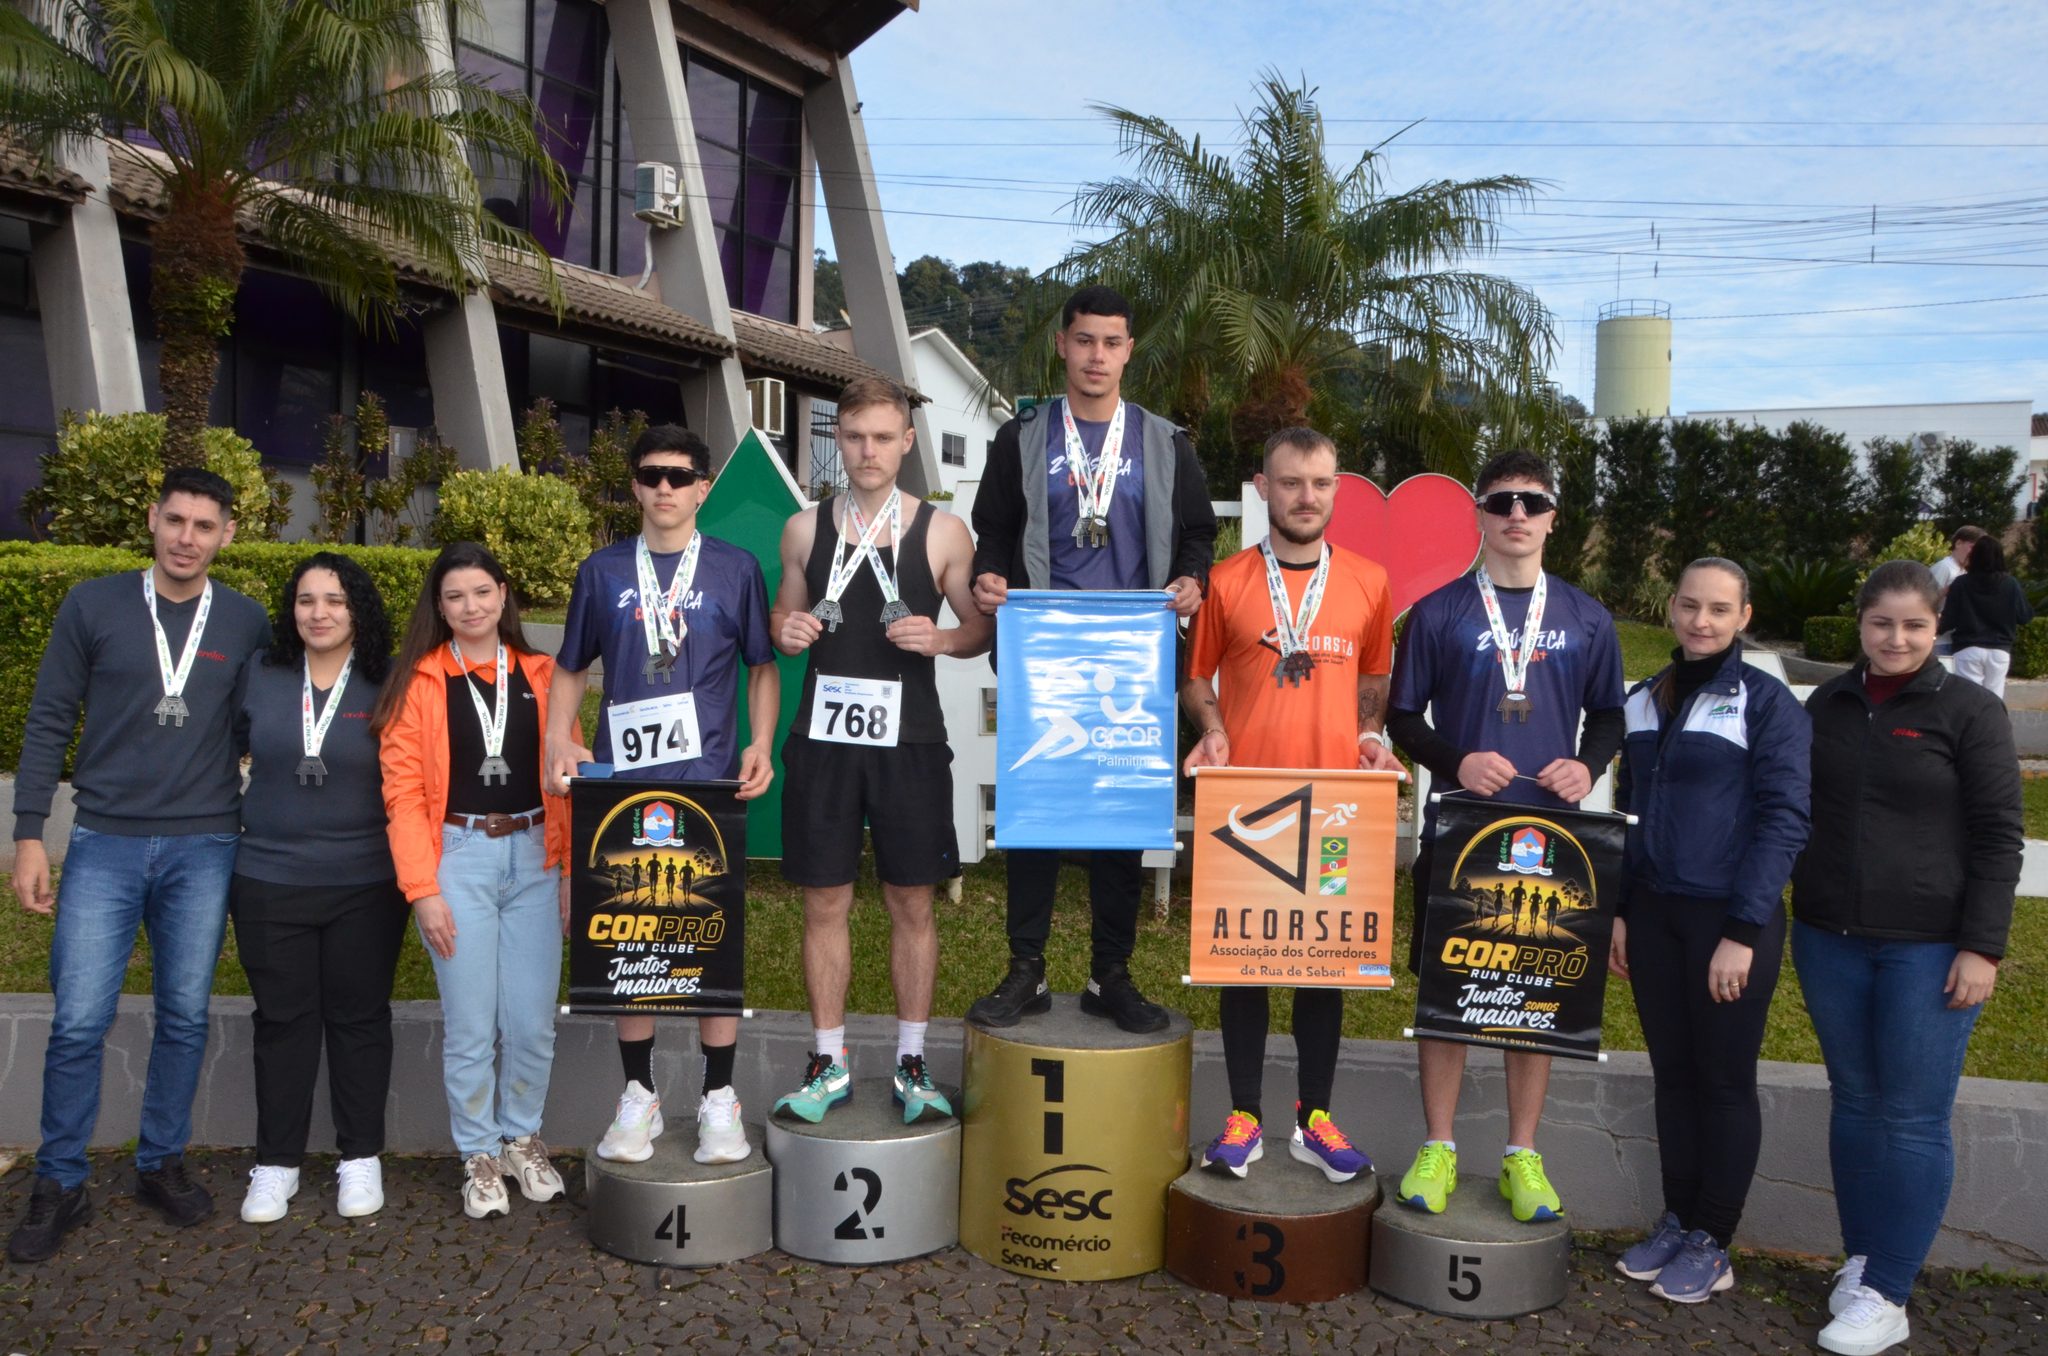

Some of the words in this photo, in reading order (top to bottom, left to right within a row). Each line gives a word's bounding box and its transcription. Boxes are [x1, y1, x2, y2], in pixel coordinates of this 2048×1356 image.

[825, 701, 888, 740] 768
[622, 719, 690, 763] 974
[587, 910, 726, 943] CORPRÓ
[1213, 907, 1379, 943] ACORSEB
[617, 942, 648, 952] RUN
[652, 943, 696, 954] CLUBE
[1210, 944, 1277, 959] Associação
[1282, 945, 1303, 958] dos
[1307, 946, 1377, 959] Corredores
[1441, 937, 1589, 979] CORPRÓ
[608, 954, 671, 980] Juntos
[671, 966, 704, 978] somos
[613, 975, 702, 995] maiores.
[1241, 964, 1256, 976] de
[1260, 965, 1283, 976] Rua
[1287, 965, 1302, 976] de
[1307, 965, 1346, 977] Seberi
[1470, 968, 1500, 981] RUN
[1506, 973, 1553, 988] CLUBE
[1457, 983, 1526, 1007] Juntos
[1524, 1000, 1560, 1012] somos
[1462, 1003, 1556, 1030] maiores.
[1031, 1058, 1064, 1155] 1
[834, 1167, 885, 1240] 2
[1003, 1177, 1113, 1221] Sesc
[654, 1205, 691, 1249] 4
[1234, 1222, 1285, 1296] 3
[1447, 1254, 1482, 1301] 5
